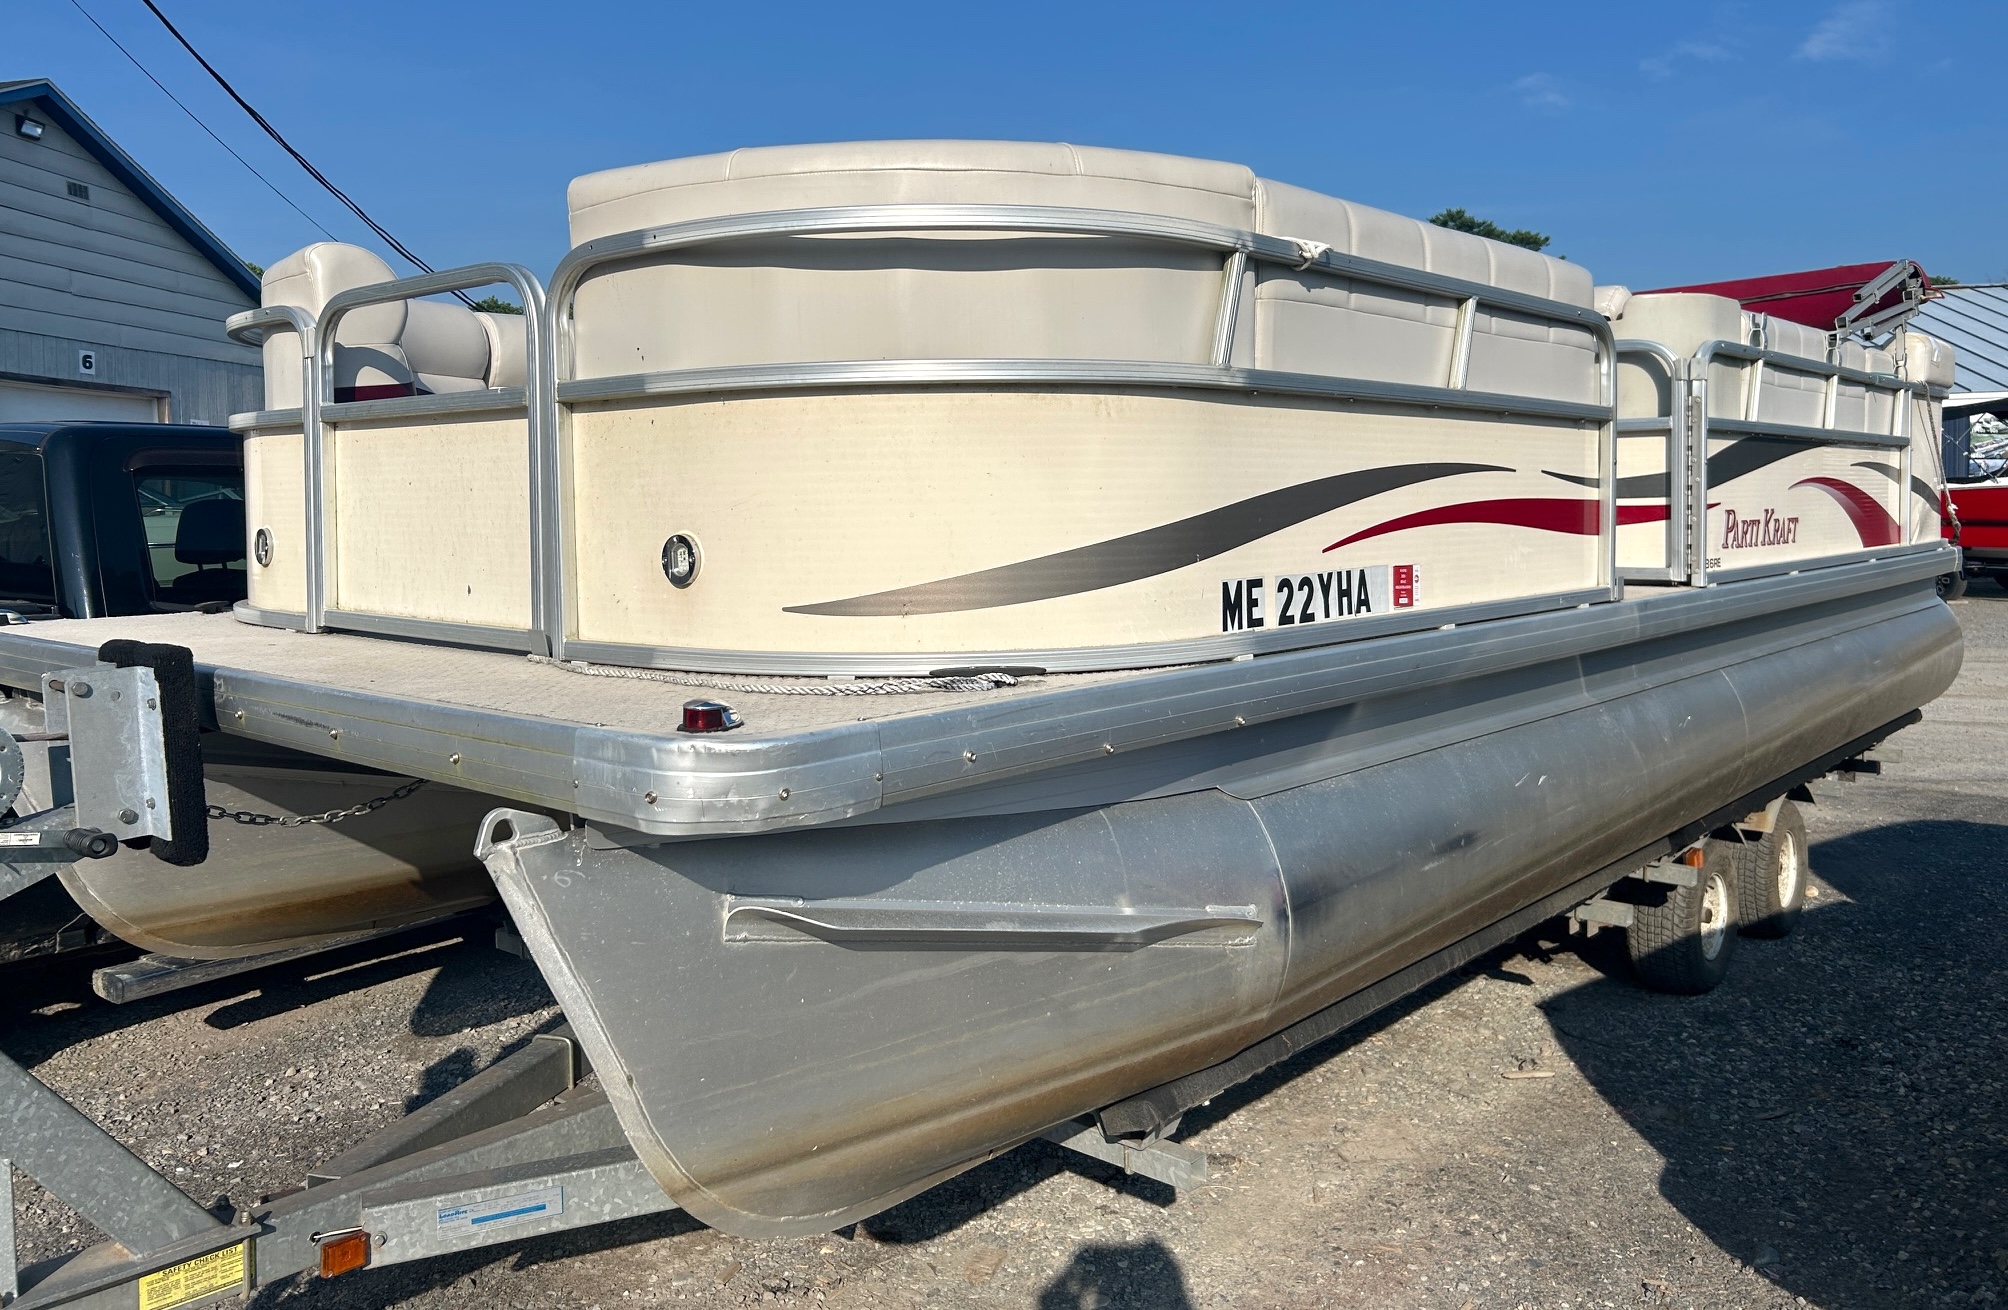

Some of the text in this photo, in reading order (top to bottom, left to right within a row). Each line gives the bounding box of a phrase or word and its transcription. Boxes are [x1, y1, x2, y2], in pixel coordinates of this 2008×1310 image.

[82, 354, 93, 370] 6
[1761, 508, 1799, 546] KRAFT
[1222, 578, 1264, 632] ME
[1277, 568, 1372, 626] 22YHA
[162, 1246, 238, 1276] SAFETY CHECK LIST
